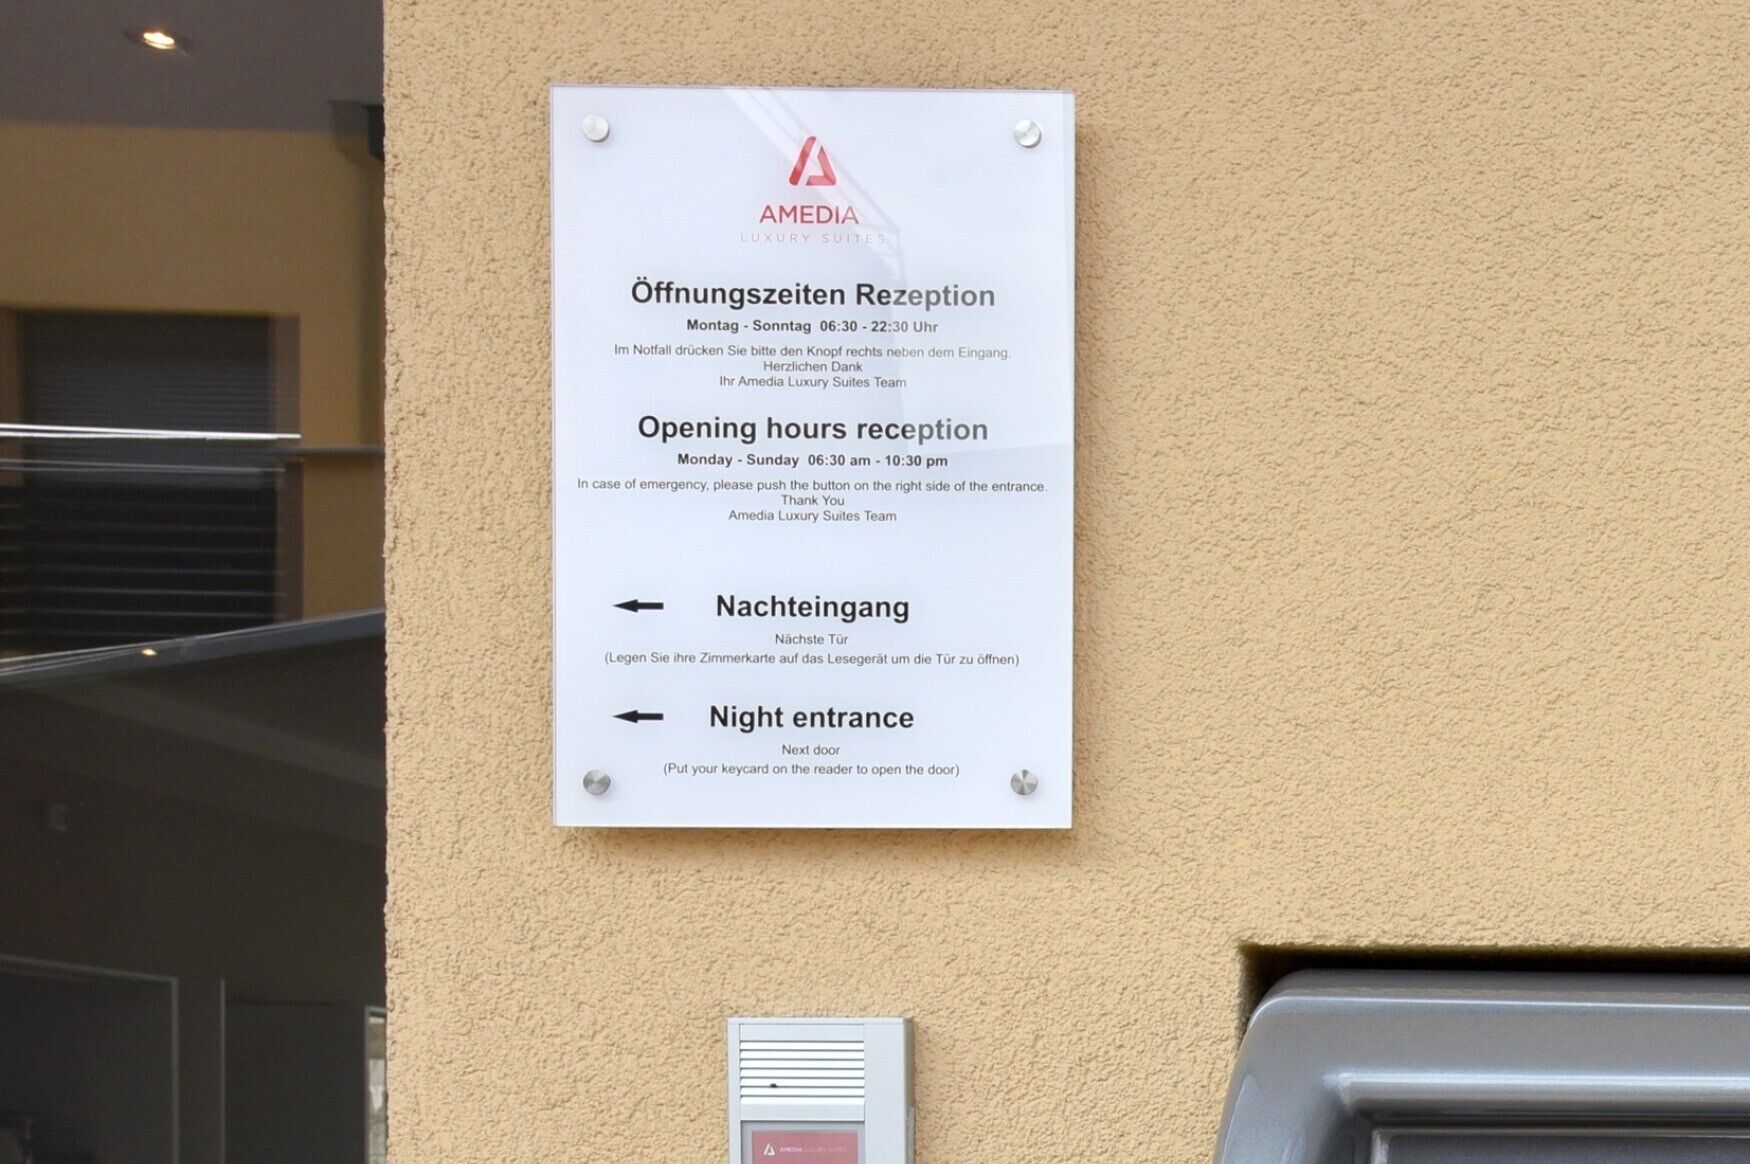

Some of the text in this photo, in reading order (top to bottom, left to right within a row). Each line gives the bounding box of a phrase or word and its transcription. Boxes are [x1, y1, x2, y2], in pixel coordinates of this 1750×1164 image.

[759, 204, 860, 224] AMEDIA
[740, 232, 886, 245] LUXURY SUITES
[631, 276, 995, 312] Öffnungszeiten Rezeption
[686, 318, 739, 335] Montag
[752, 319, 812, 335] Sonntag
[819, 319, 858, 333] 06:30
[870, 320, 909, 333] 22:30
[912, 320, 939, 333] Uhr
[614, 343, 1012, 361] Im Notfall drücken Sie bitte den Knopf rechts neben dem Eingang.
[763, 360, 863, 373] Herzlichen Dank
[719, 375, 907, 390] Ihr Amedia Luxury Suites Team
[638, 415, 988, 446] Opening hours reception
[677, 452, 733, 469] Monday
[746, 453, 800, 469] Sunday
[807, 453, 846, 467] 06:30
[849, 456, 871, 467] am
[884, 454, 922, 467] 10:30
[926, 457, 948, 470] pm
[577, 477, 1048, 494] In case of emergency, please push the button on the right side of the entrance.
[780, 494, 845, 507] Thank You
[728, 509, 897, 524] Amedia Luxury Suites Team
[716, 594, 909, 624] Nachteingang
[775, 633, 849, 645] Nächste Tür
[604, 651, 1020, 668] (Legen Sie ihre Zimmerkarte auf das Lesegerät um die Tür zu öffnen)
[710, 705, 914, 734] Night entrance
[781, 744, 841, 756] Next door
[663, 762, 960, 778] (Put your keycard on the reader to open the door)
